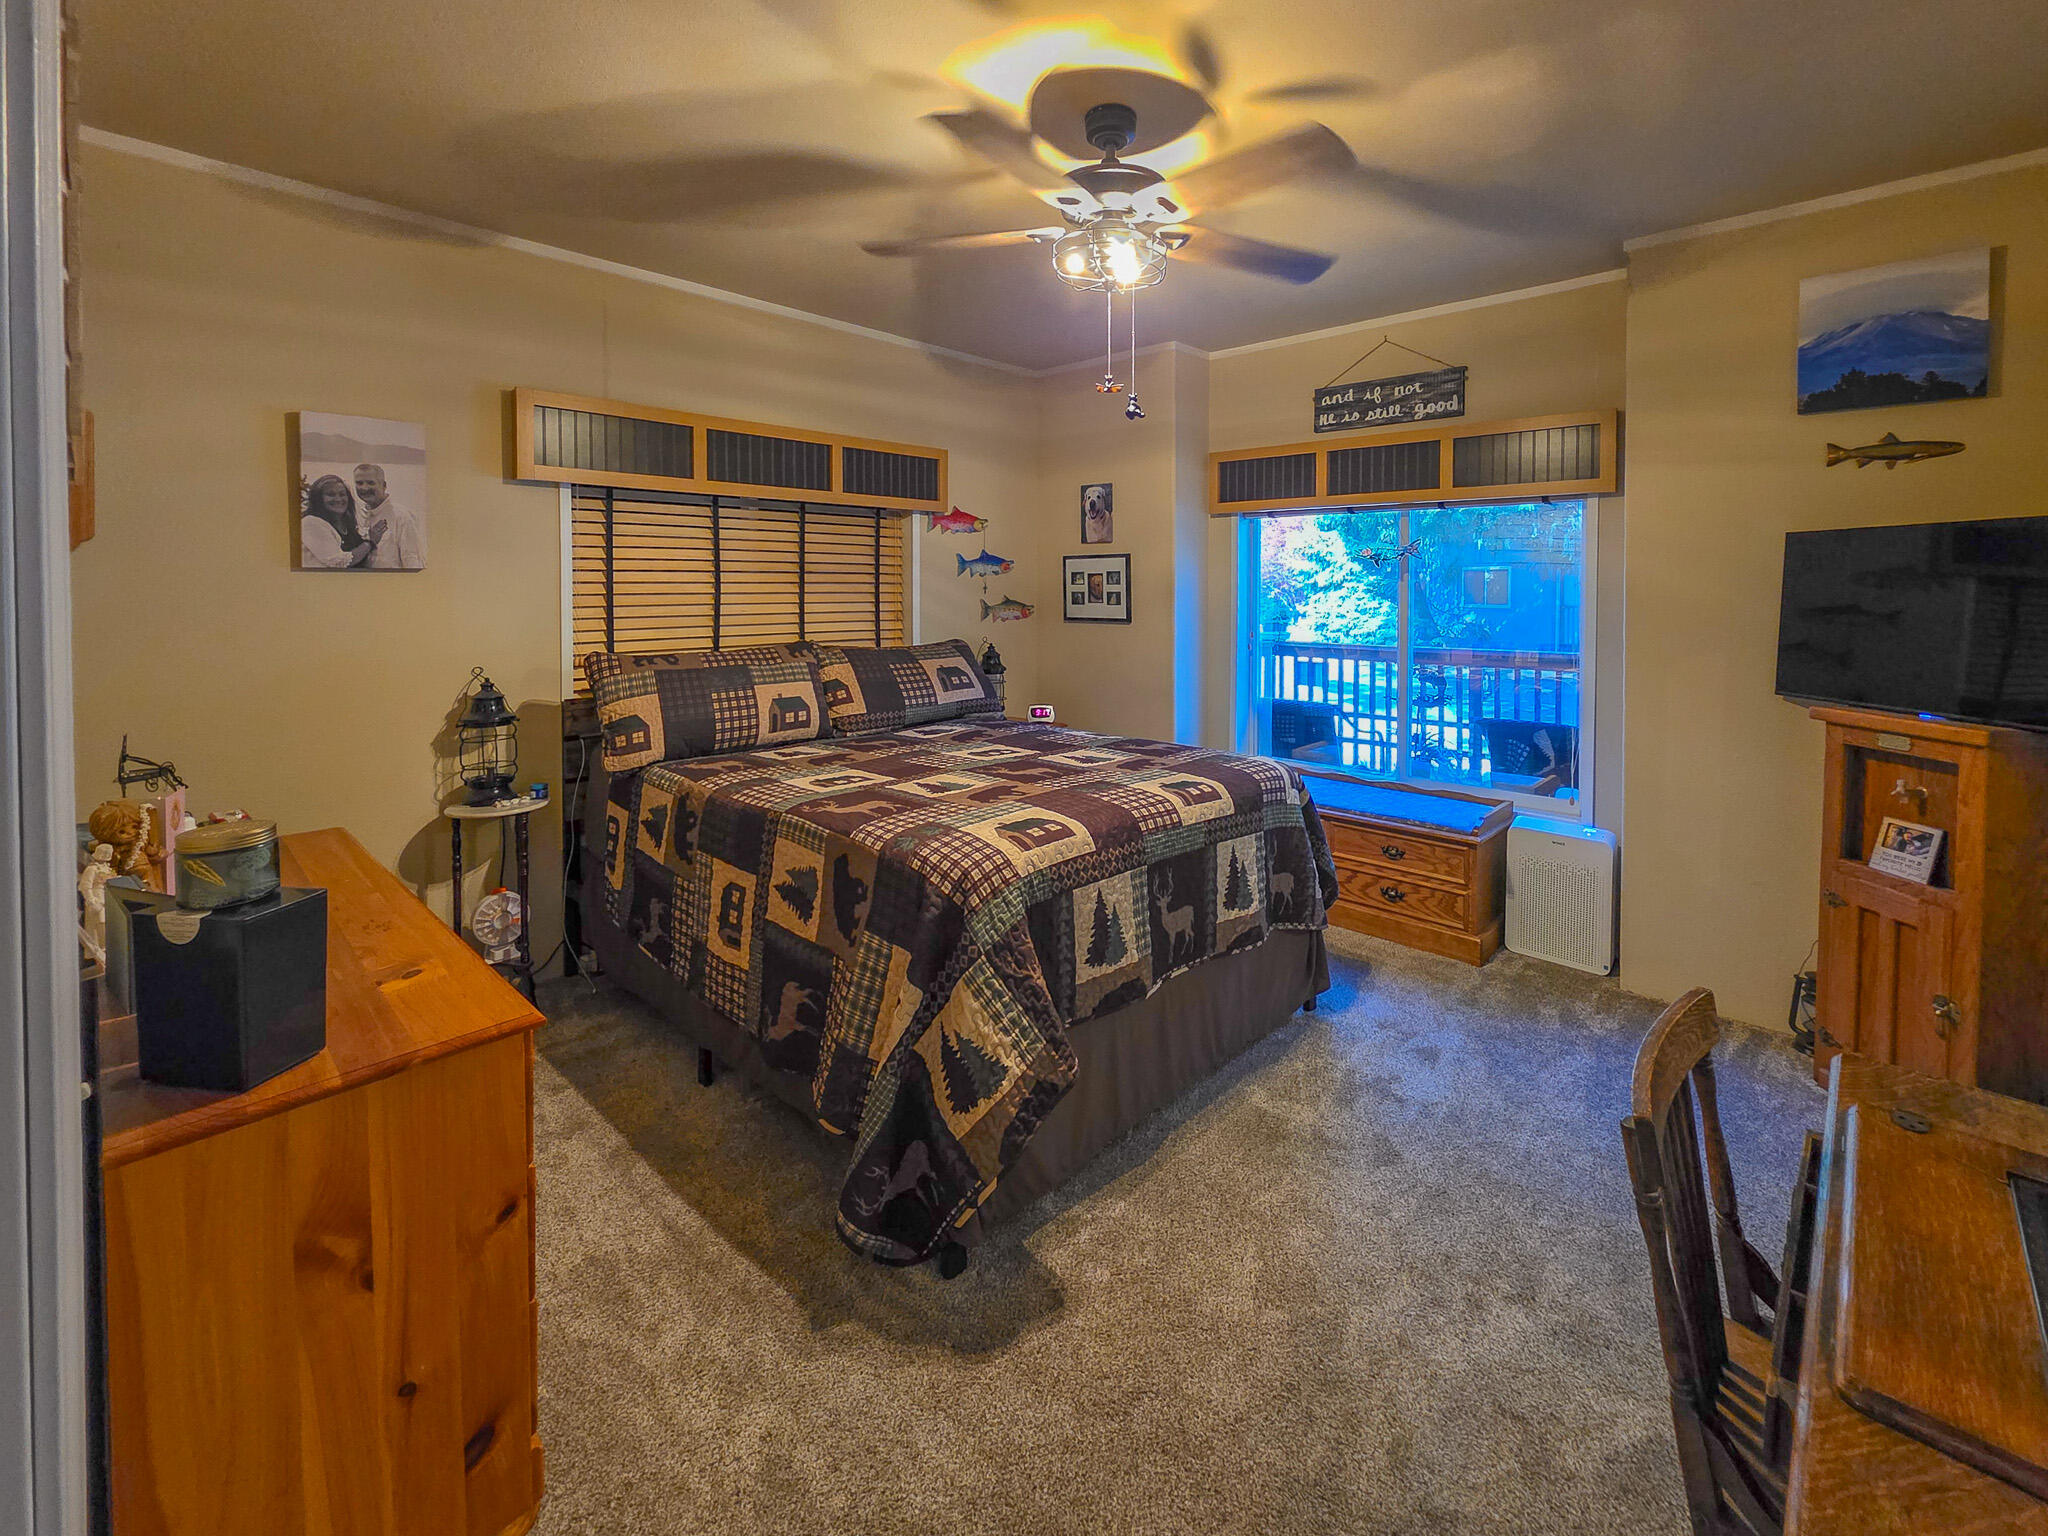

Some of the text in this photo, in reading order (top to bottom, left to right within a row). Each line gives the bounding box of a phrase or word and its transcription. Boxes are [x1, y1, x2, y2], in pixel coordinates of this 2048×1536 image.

[1321, 383, 1423, 405] and if not
[1340, 410, 1360, 423] is
[1364, 404, 1403, 420] still
[1414, 394, 1458, 419] good
